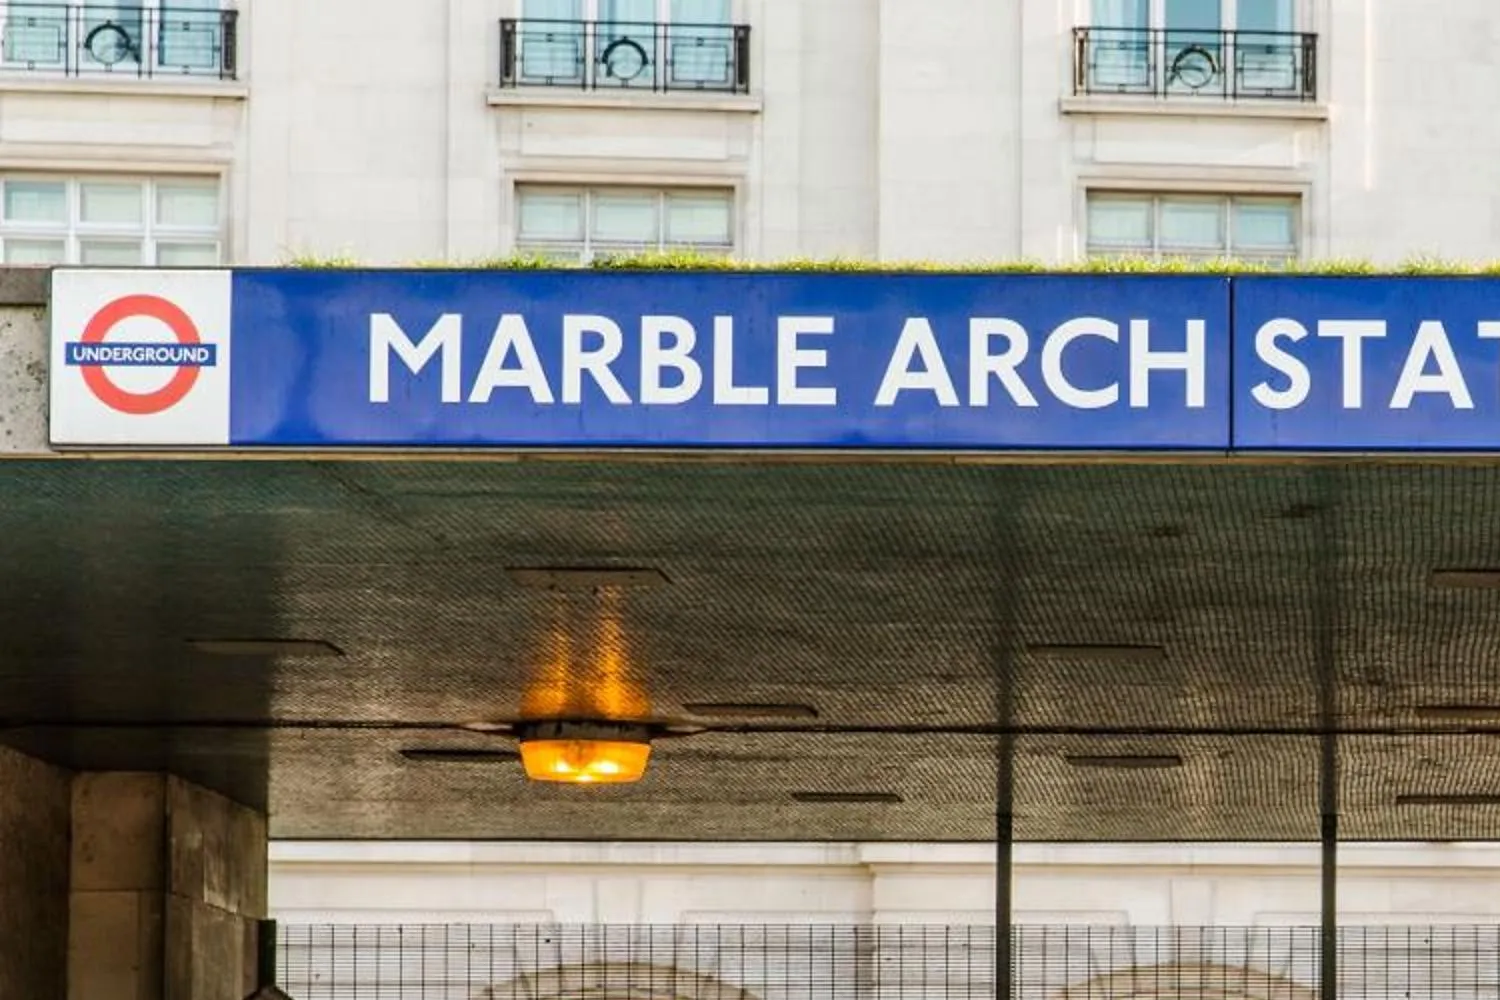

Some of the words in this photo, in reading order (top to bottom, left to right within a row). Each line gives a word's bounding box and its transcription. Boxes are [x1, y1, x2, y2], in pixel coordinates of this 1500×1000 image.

[73, 346, 209, 361] UNDERGROUND
[368, 312, 838, 406] MARBLE
[873, 317, 1206, 409] ARCH
